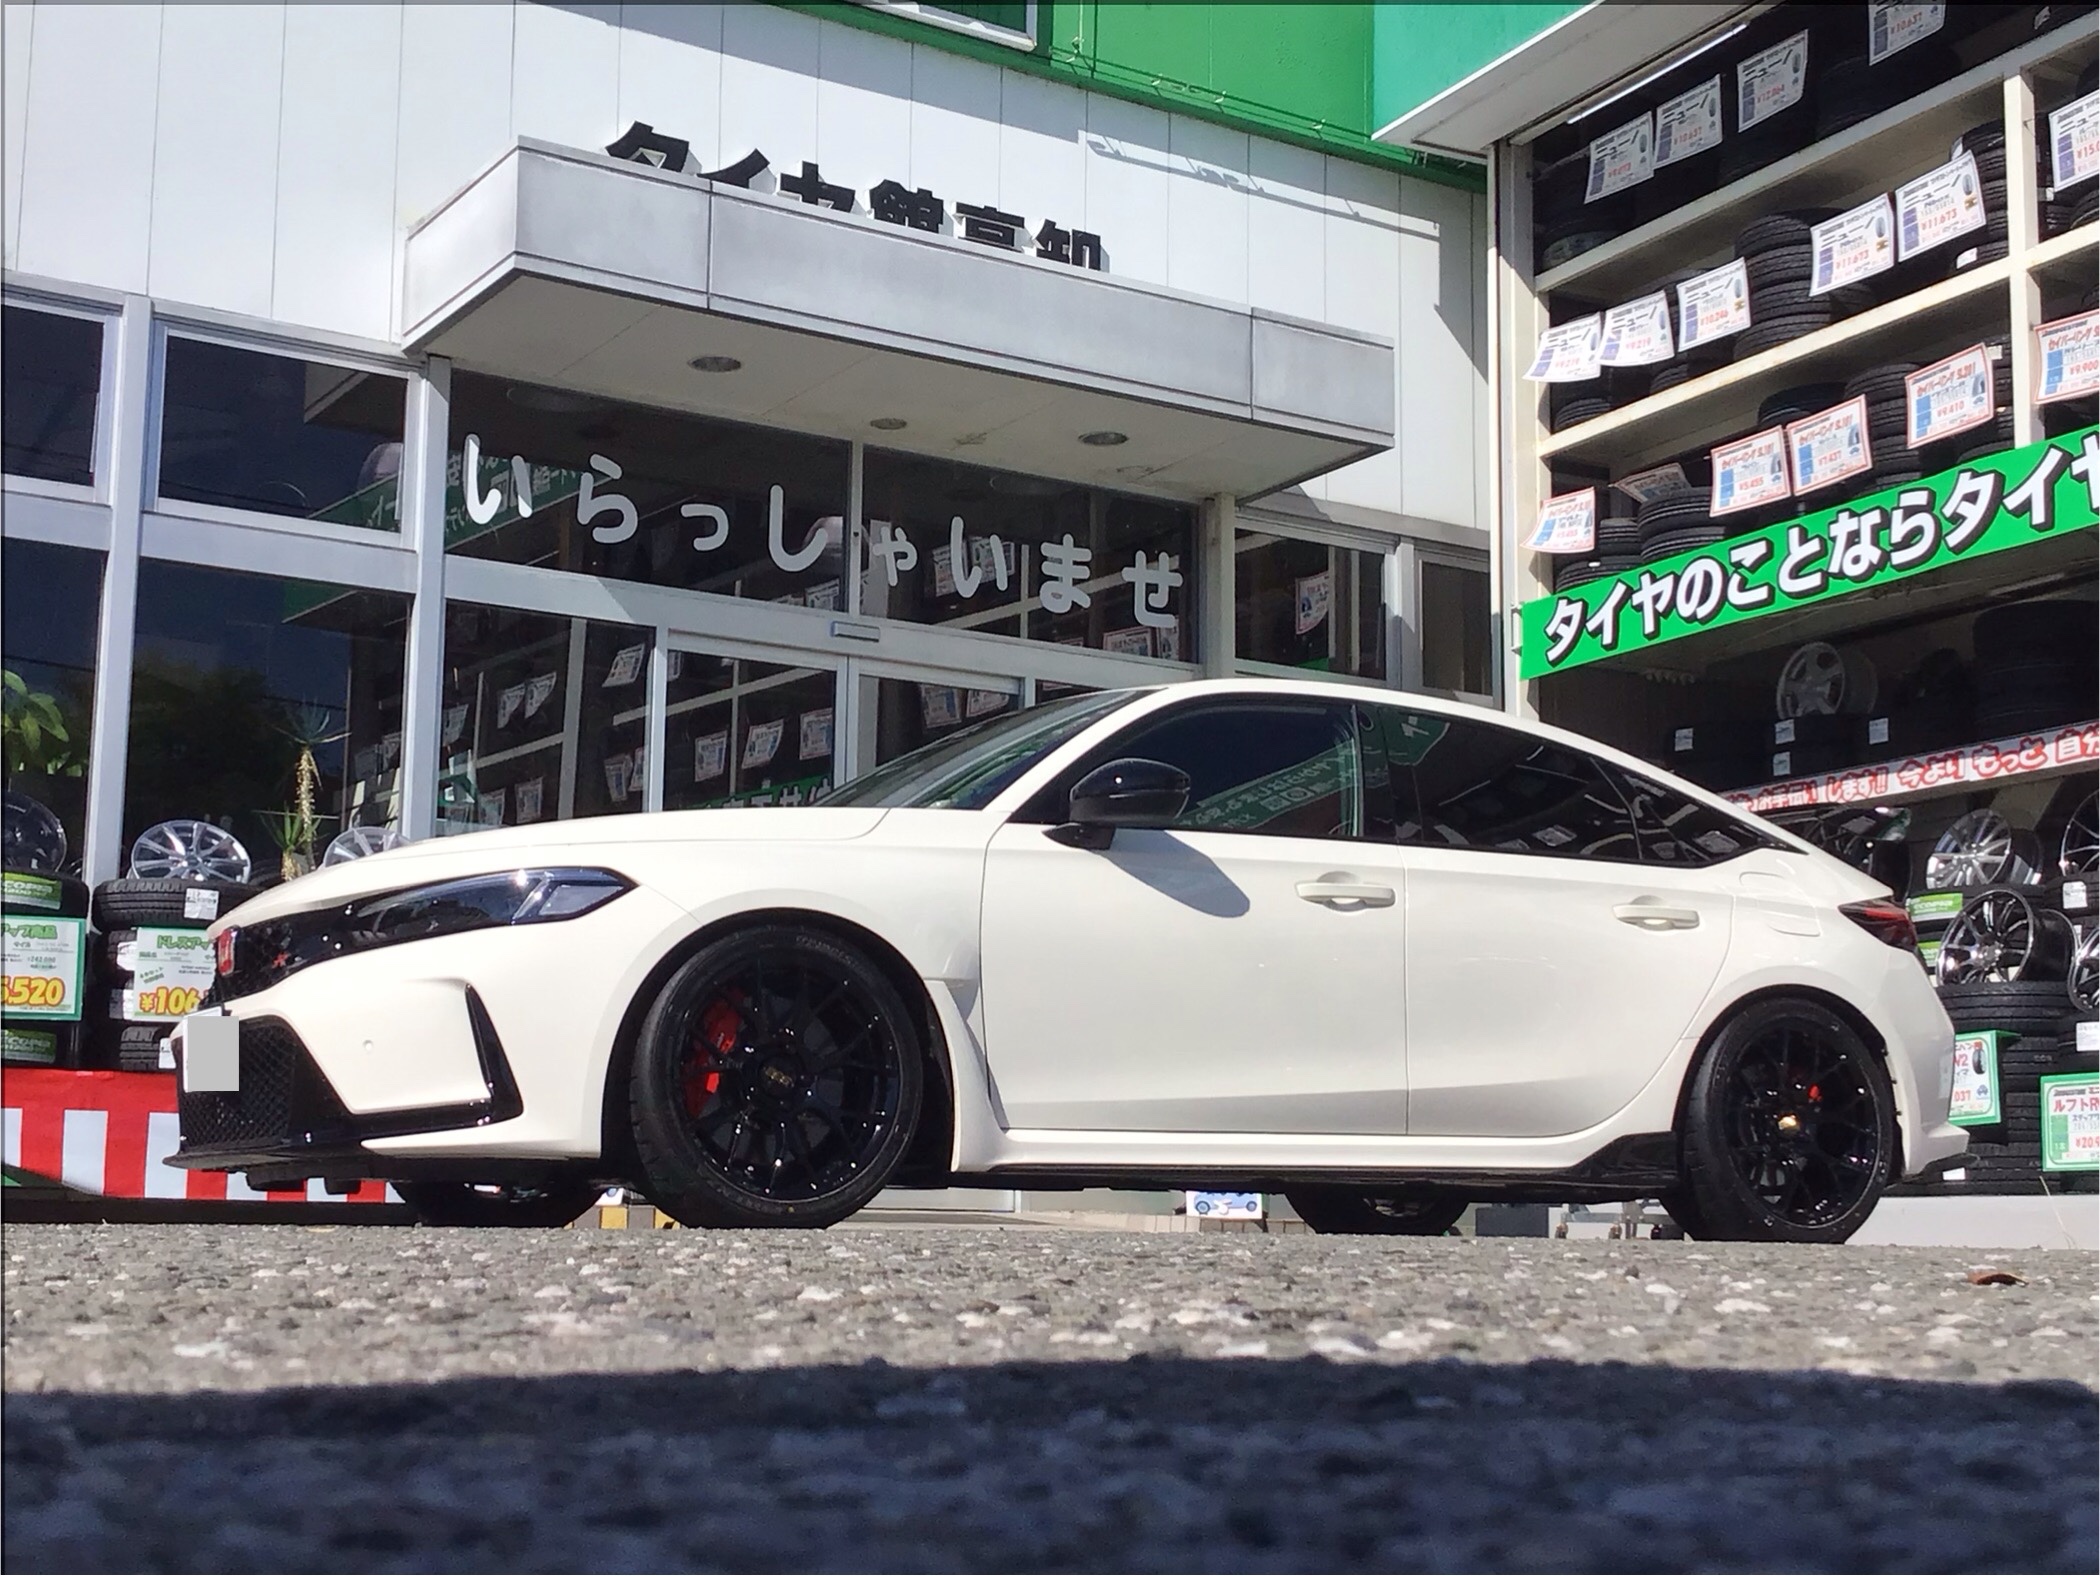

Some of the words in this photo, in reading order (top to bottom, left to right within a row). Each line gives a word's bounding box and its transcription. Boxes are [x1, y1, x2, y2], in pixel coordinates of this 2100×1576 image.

[463, 433, 1183, 629] いらっしゃいませ
[1971, 734, 2049, 778] もっと
